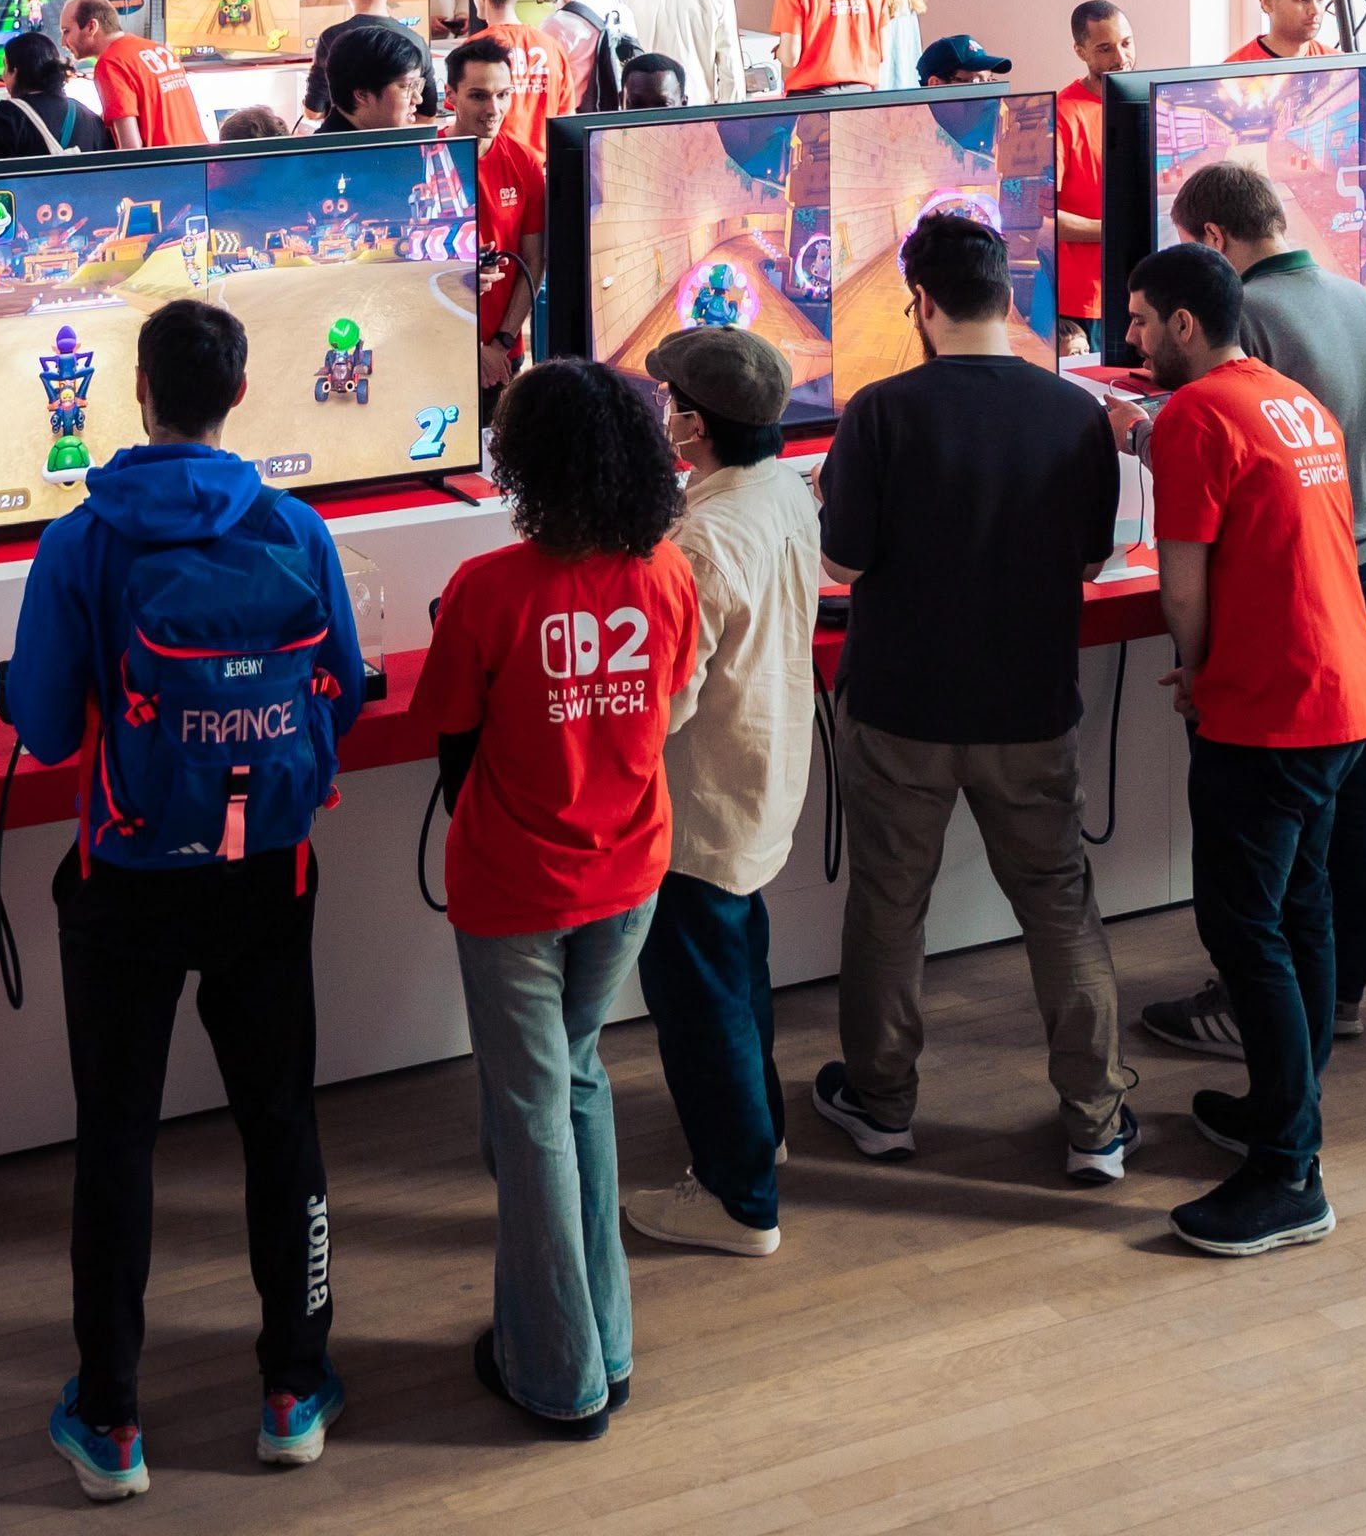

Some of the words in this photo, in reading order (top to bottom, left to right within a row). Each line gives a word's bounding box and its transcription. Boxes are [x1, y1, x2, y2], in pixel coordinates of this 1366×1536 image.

[154, 46, 181, 71] 2
[527, 46, 550, 75] 2
[509, 186, 517, 198] 2
[1293, 395, 1337, 447] 2
[283, 458, 306, 473] 2/3
[1293, 451, 1341, 468] NINTENDO
[1299, 463, 1346, 488] SWITCH
[0, 494, 25, 509] 2/3
[604, 606, 650, 673] 2
[223, 656, 263, 678] JÉRÉMY
[548, 679, 645, 702] NINTENDO
[548, 693, 645, 723] SWITCH
[182, 699, 297, 743] FRANCE
[306, 1194, 330, 1316] Joma
